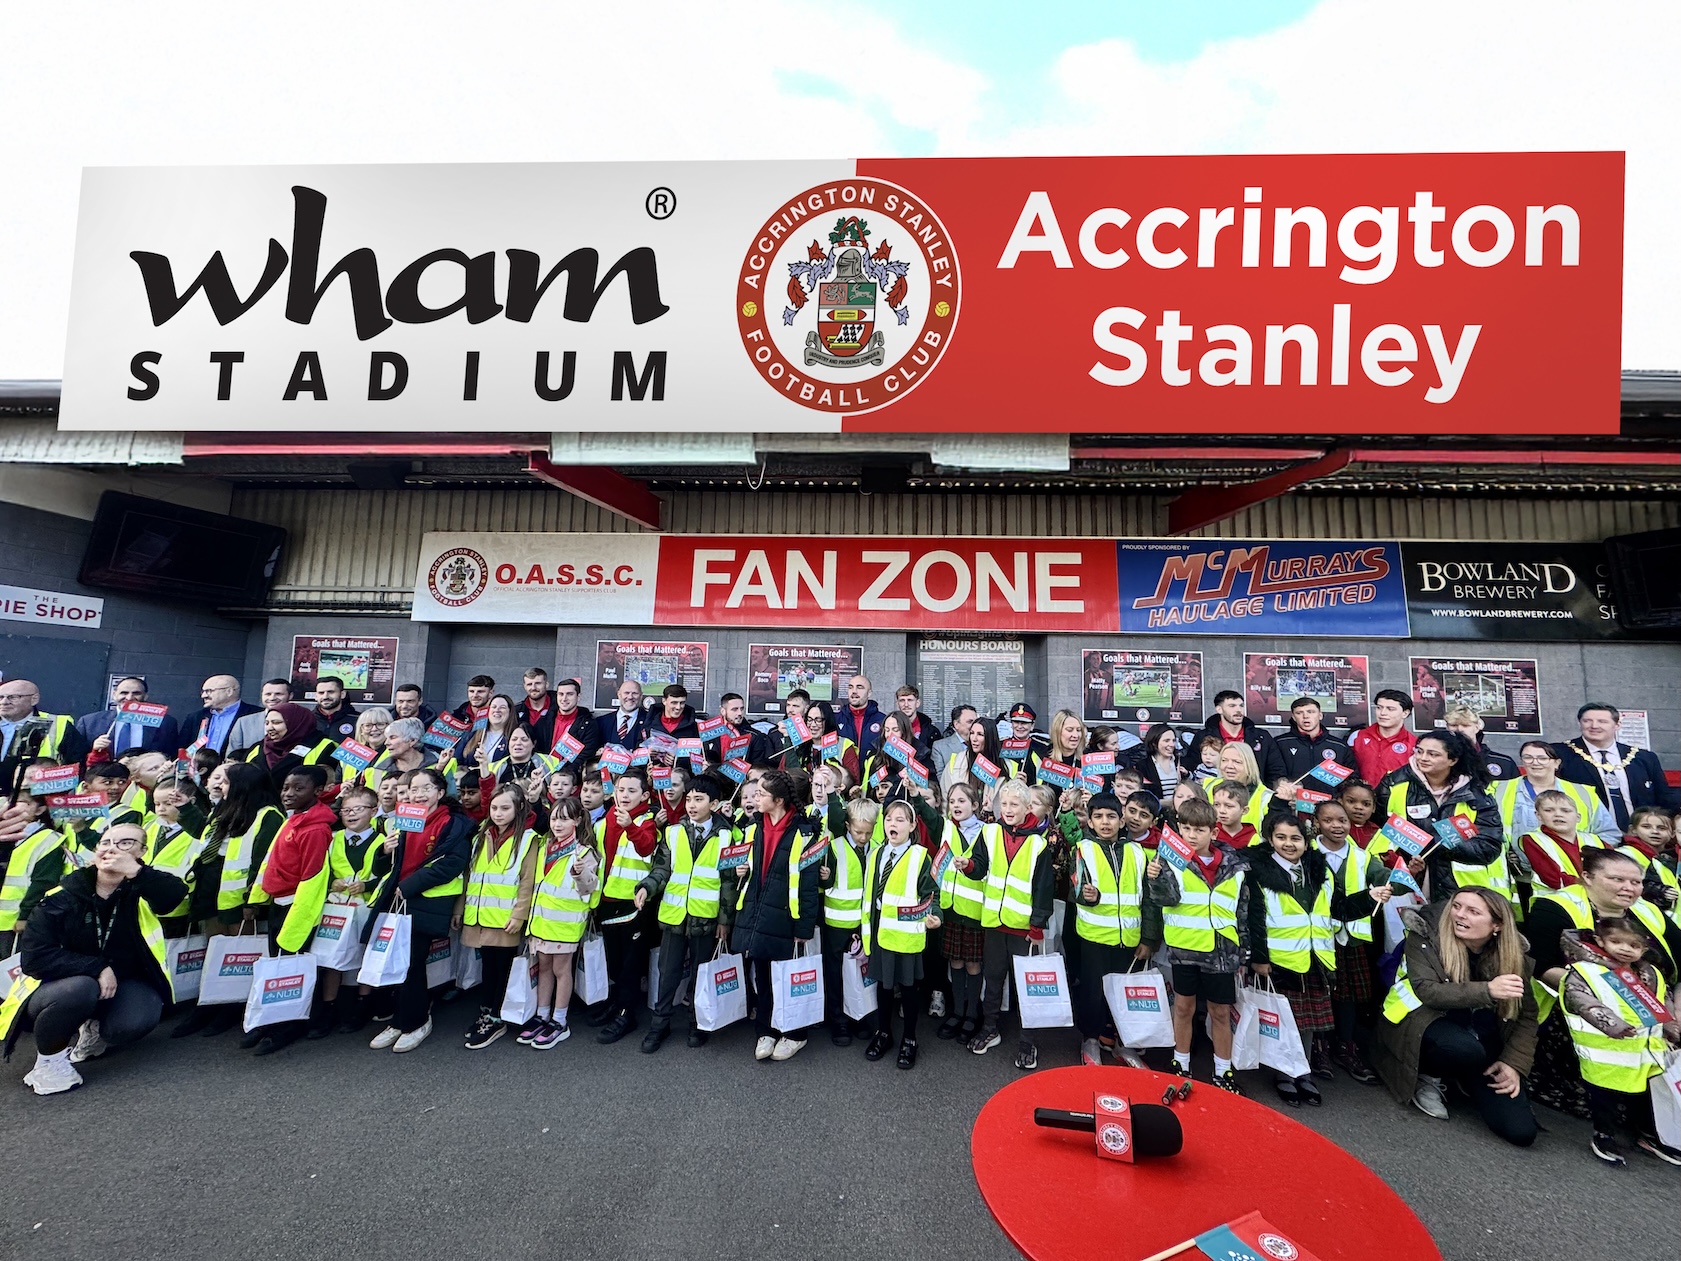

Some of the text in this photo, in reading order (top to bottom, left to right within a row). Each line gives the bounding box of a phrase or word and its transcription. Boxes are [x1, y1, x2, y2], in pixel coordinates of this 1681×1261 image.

[744, 186, 952, 289] ACCRINGTON STANLEY
[998, 187, 1581, 284] Accrington
[130, 185, 669, 341] wham
[809, 351, 829, 363] INDUSTRY
[861, 351, 880, 362] CONQUER
[1088, 303, 1482, 404] Stanley
[747, 328, 942, 406] FOOTBALL CLUB
[127, 351, 668, 401] STADIUM
[430, 549, 488, 576] ACCRINGTON STANLEY
[495, 563, 642, 586] O.A.S.S.C.
[1417, 562, 1576, 593] BOWLAND
[690, 548, 1085, 614] FAN ZONE
[430, 586, 484, 607] FOOTBALL CLUB
[1454, 585, 1538, 599] BREWERY
[34, 595, 59, 603] THE
[1148, 584, 1376, 628] HAULAGE LIMITED
[36, 604, 97, 621] SHOP
[1432, 609, 1573, 619] WWW.BOWLANDBREWERY.COM
[312, 639, 330, 648] Goals
[332, 640, 346, 648] that
[616, 645, 636, 653] Goals
[920, 640, 1021, 650] HONOURS BOARD
[769, 649, 789, 658] Goals
[791, 649, 806, 657] that
[1103, 654, 1126, 664] Goals
[1126, 655, 1142, 663] that
[1266, 658, 1287, 667] Goals
[1289, 659, 1306, 667] that
[1432, 662, 1454, 671] Goals
[1456, 662, 1473, 671] that
[134, 714, 159, 724] NLTG
[707, 728, 724, 737] NLTG
[791, 728, 801, 742] NLTG
[432, 737, 452, 747] NLTG
[344, 752, 365, 767] NLTG
[608, 763, 624, 771] NLTG
[725, 765, 742, 780] NLTG
[979, 770, 993, 783] NLTG
[1047, 772, 1066, 784] NLTG
[44, 779, 74, 789] NLTG
[1084, 781, 1101, 794] NLTG
[402, 819, 422, 828] NLTG
[1394, 833, 1420, 852] NLTG
[729, 854, 748, 865] NLTG
[1161, 848, 1184, 868] NLTG
[326, 928, 341, 937] NLTG
[432, 948, 449, 959] NLTG
[723, 981, 737, 991] NLTG
[800, 982, 816, 992] NLTG
[1038, 985, 1056, 993] NLTG
[277, 988, 300, 998] NLTG
[1139, 1000, 1158, 1008] NLTG
[1620, 988, 1651, 1018] NLTG
